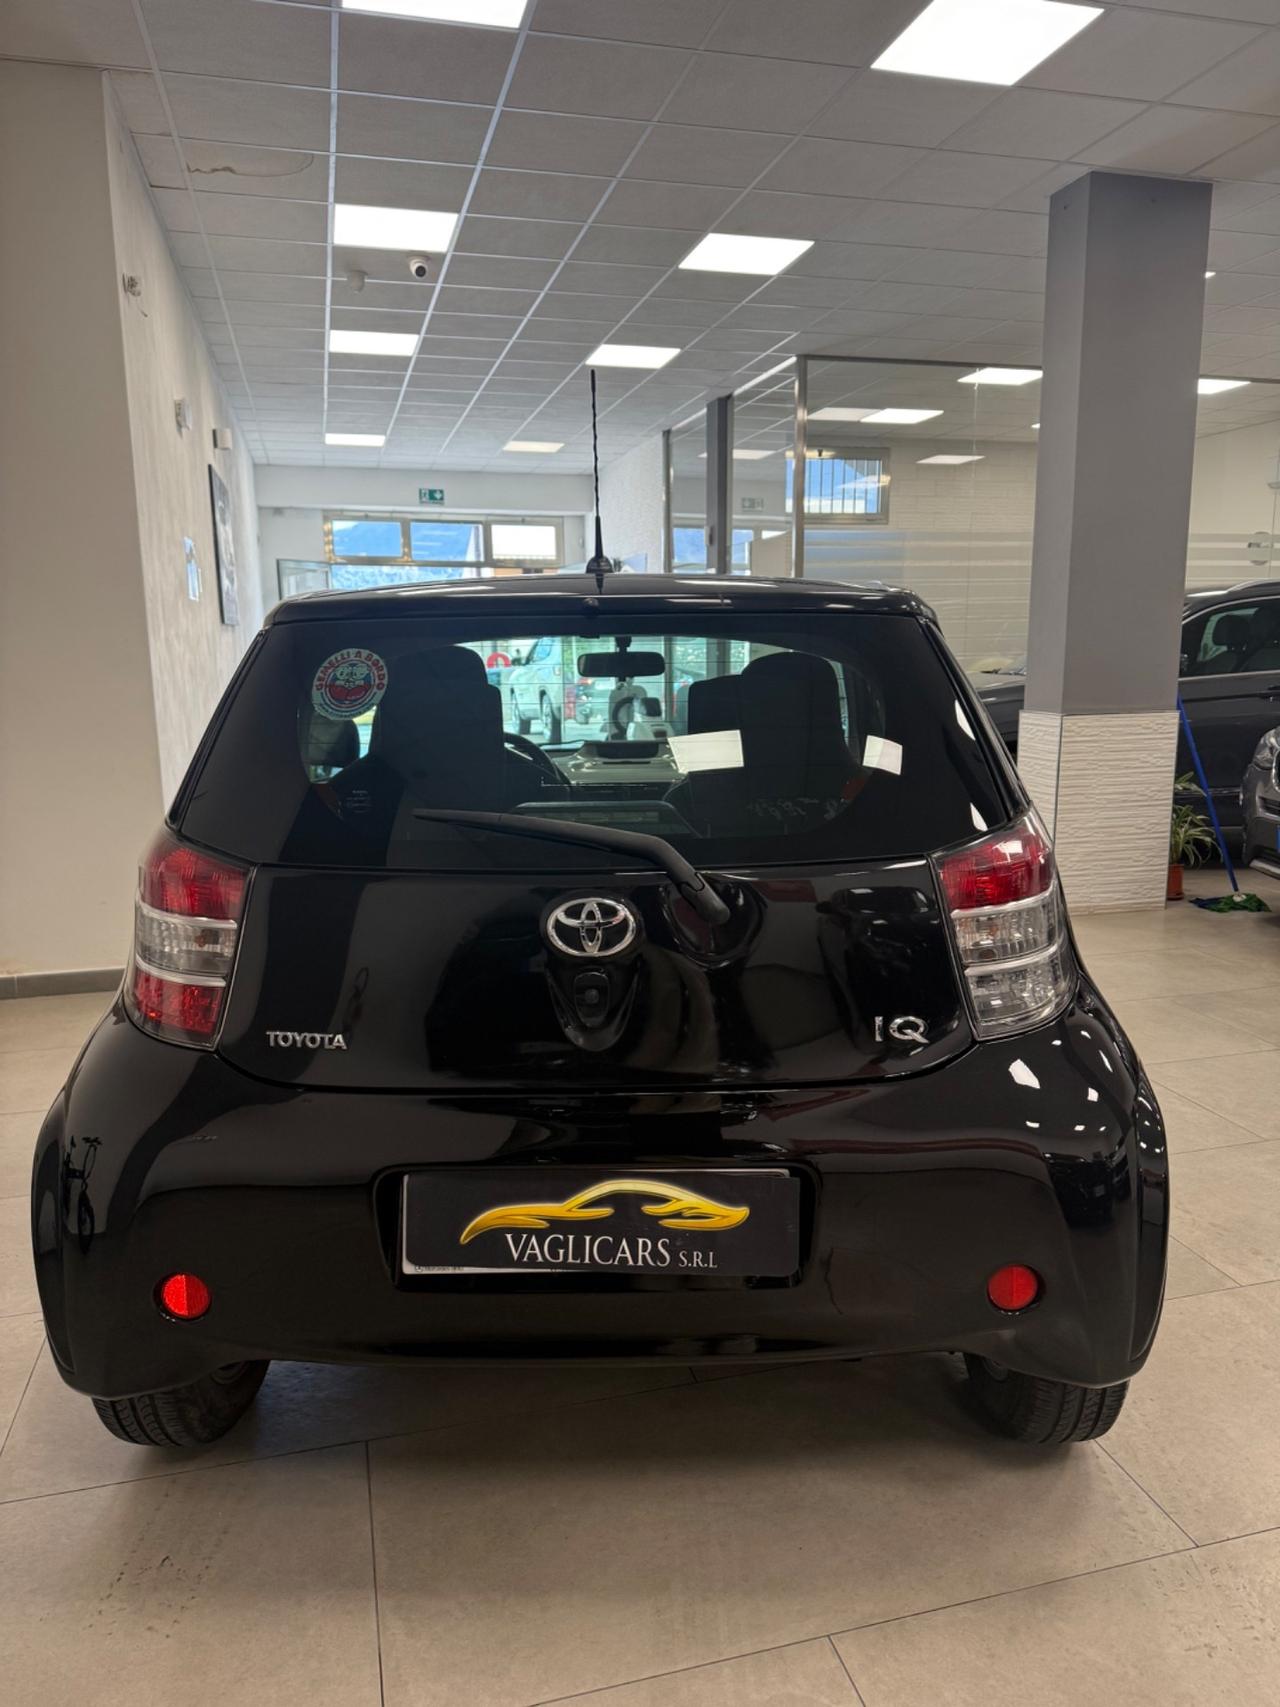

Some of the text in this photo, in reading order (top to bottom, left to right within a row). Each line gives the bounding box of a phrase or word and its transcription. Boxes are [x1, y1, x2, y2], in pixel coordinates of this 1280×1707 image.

[354, 650, 363, 659] A
[364, 653, 386, 691] BORDO
[266, 1031, 347, 1050] TOYOTA
[504, 1232, 672, 1267] VAGLICARS
